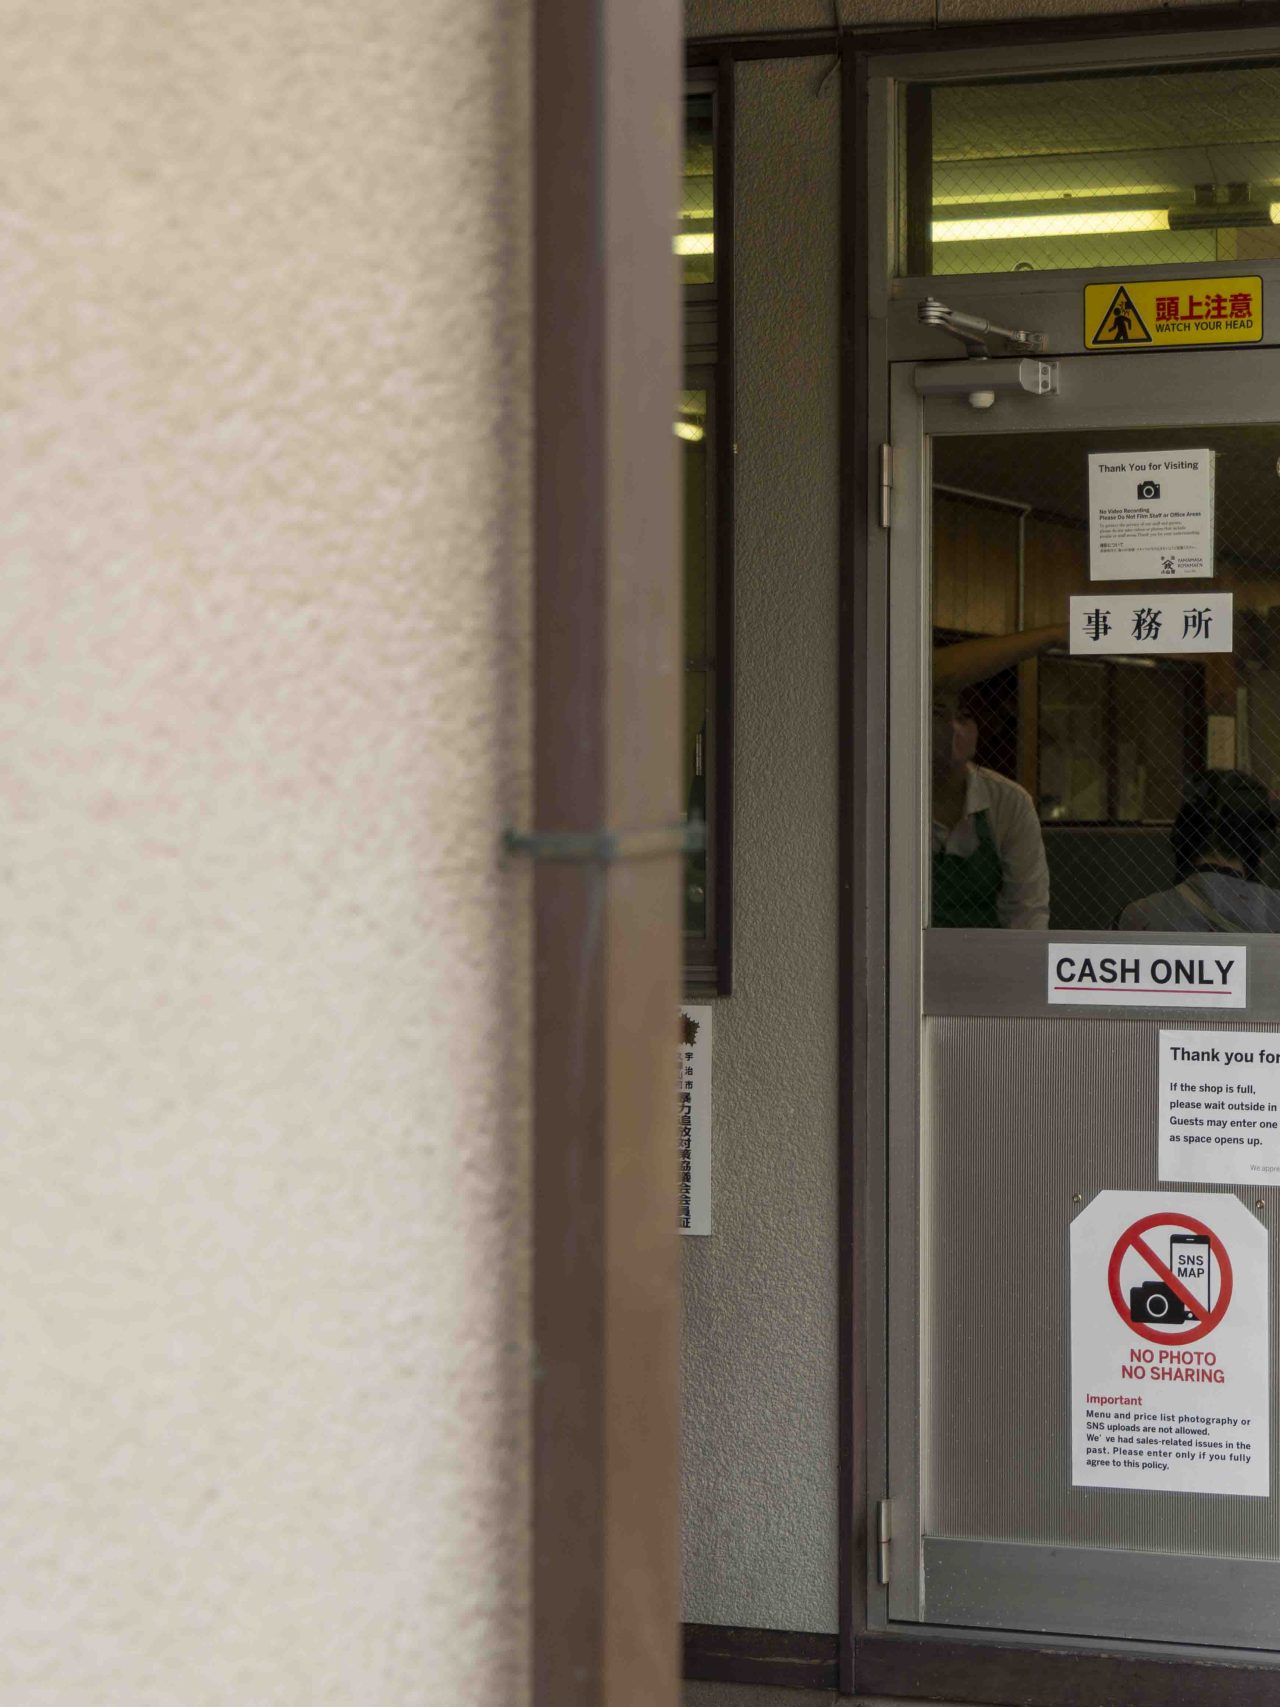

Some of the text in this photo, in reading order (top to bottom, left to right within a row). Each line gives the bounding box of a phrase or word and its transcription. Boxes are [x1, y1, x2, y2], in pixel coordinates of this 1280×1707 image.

[1156, 293, 1252, 321] 頭上注意
[1156, 320, 1253, 332] WATCH YOUR HEAD
[1099, 464, 1126, 472] Thank
[1129, 463, 1145, 471] You
[1164, 461, 1199, 470] Visiting
[1082, 608, 1212, 641] 事務所
[1056, 958, 1234, 985] CASH ONLY
[1170, 1047, 1220, 1062] Thank
[1224, 1051, 1254, 1065] you
[1170, 1083, 1255, 1095] If the shop is full,
[1170, 1101, 1201, 1110] please
[1204, 1101, 1225, 1110] wait
[1228, 1102, 1265, 1111] outside
[1268, 1103, 1277, 1111] in
[1170, 1116, 1204, 1126] Guests
[1207, 1119, 1227, 1128] may
[1230, 1119, 1257, 1127] enter
[1260, 1121, 1278, 1129] one
[1183, 1135, 1211, 1144] space
[1214, 1137, 1244, 1145] opens
[1247, 1137, 1263, 1146] up.
[1178, 1254, 1204, 1266] SNS
[1177, 1267, 1205, 1278] MAP
[1130, 1349, 1216, 1365] NO PHOTO
[1122, 1365, 1225, 1383] NO SHARING
[1086, 1394, 1143, 1406] Important
[1086, 1410, 1111, 1418] Menu
[1114, 1411, 1131, 1419] and
[1134, 1412, 1157, 1421] price
[1161, 1413, 1175, 1421] list
[1178, 1414, 1238, 1426] photography
[1086, 1422, 1105, 1430] SNS
[1107, 1423, 1140, 1432] uploads
[1175, 1426, 1210, 1435] allowed.
[1118, 1435, 1133, 1443] had
[1136, 1436, 1193, 1446] sales-related
[1195, 1439, 1223, 1448] issues
[1236, 1441, 1251, 1449] the
[1086, 1447, 1109, 1455] past.
[1113, 1447, 1143, 1456] Please
[1147, 1450, 1172, 1458] enter
[1176, 1450, 1195, 1460] only
[1199, 1451, 1206, 1459] if
[1230, 1453, 1251, 1463] fully
[1112, 1459, 1121, 1467] to
[1124, 1459, 1139, 1468] this
[1142, 1461, 1169, 1471] policy.
